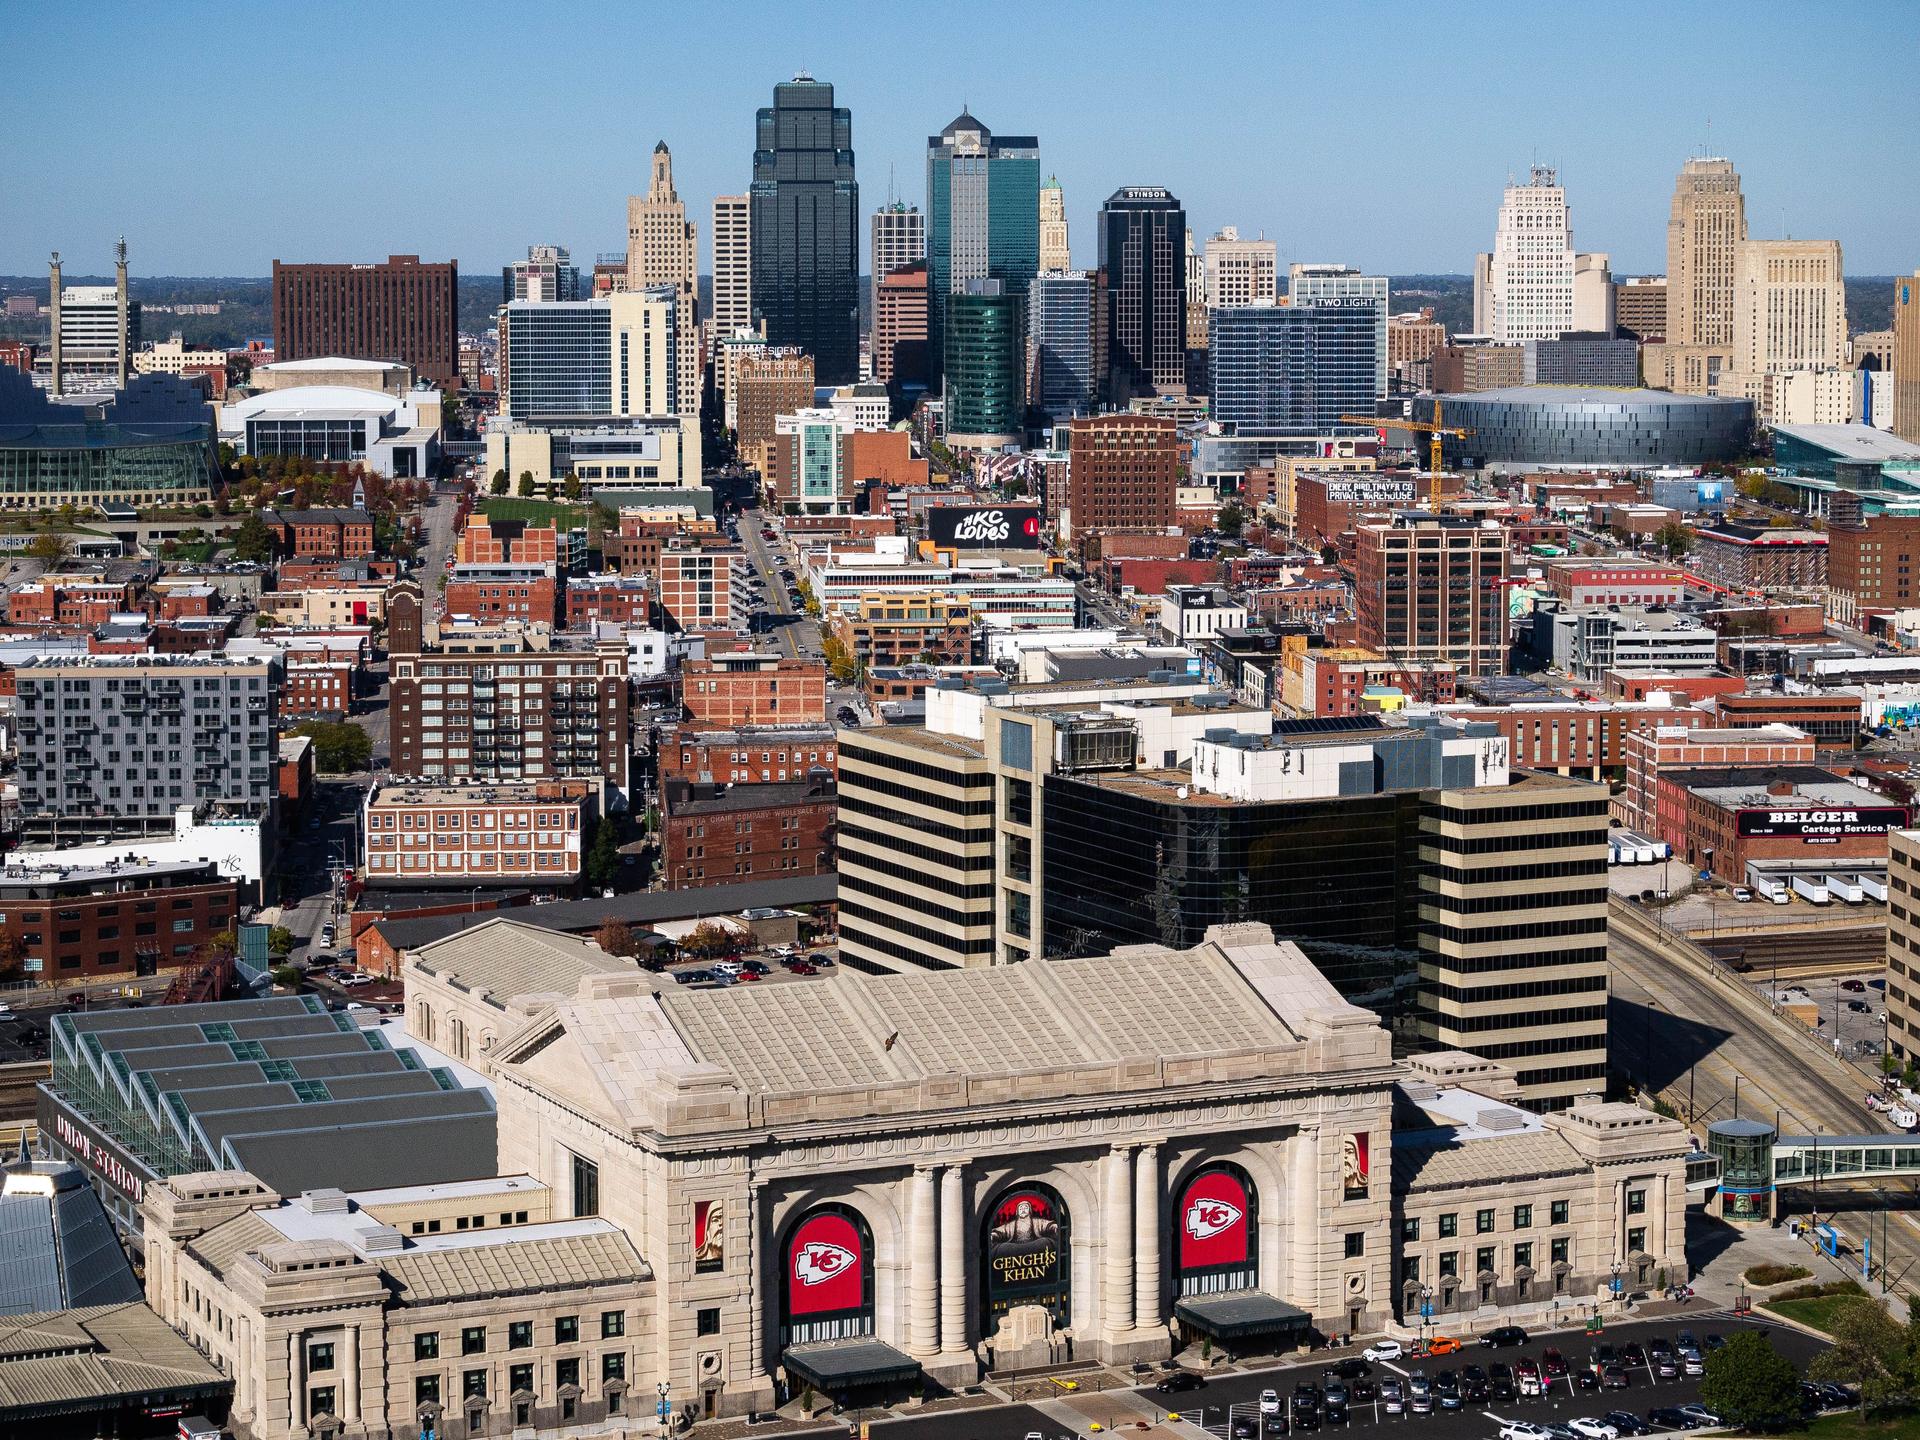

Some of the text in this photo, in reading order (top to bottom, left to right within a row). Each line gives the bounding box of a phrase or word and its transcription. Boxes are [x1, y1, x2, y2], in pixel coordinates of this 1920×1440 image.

[1318, 299, 1374, 307] TWO LIGHT
[751, 346, 803, 355] RESIDENT
[1330, 491, 1413, 500] PRIVATE WAREHOUSE
[1704, 486, 1715, 499] KC
[736, 811, 769, 822] COMPANY
[775, 808, 814, 818] WHOLESALE
[1769, 811, 1859, 823] BELGER
[1801, 825, 1842, 835] Cartage
[221, 854, 242, 872] KC
[57, 1114, 143, 1203] UNION STATION
[1198, 1206, 1229, 1227] KC
[809, 1250, 842, 1272] KC
[993, 1246, 1057, 1270] GENGHIS
[1004, 1265, 1046, 1282] KHAN
